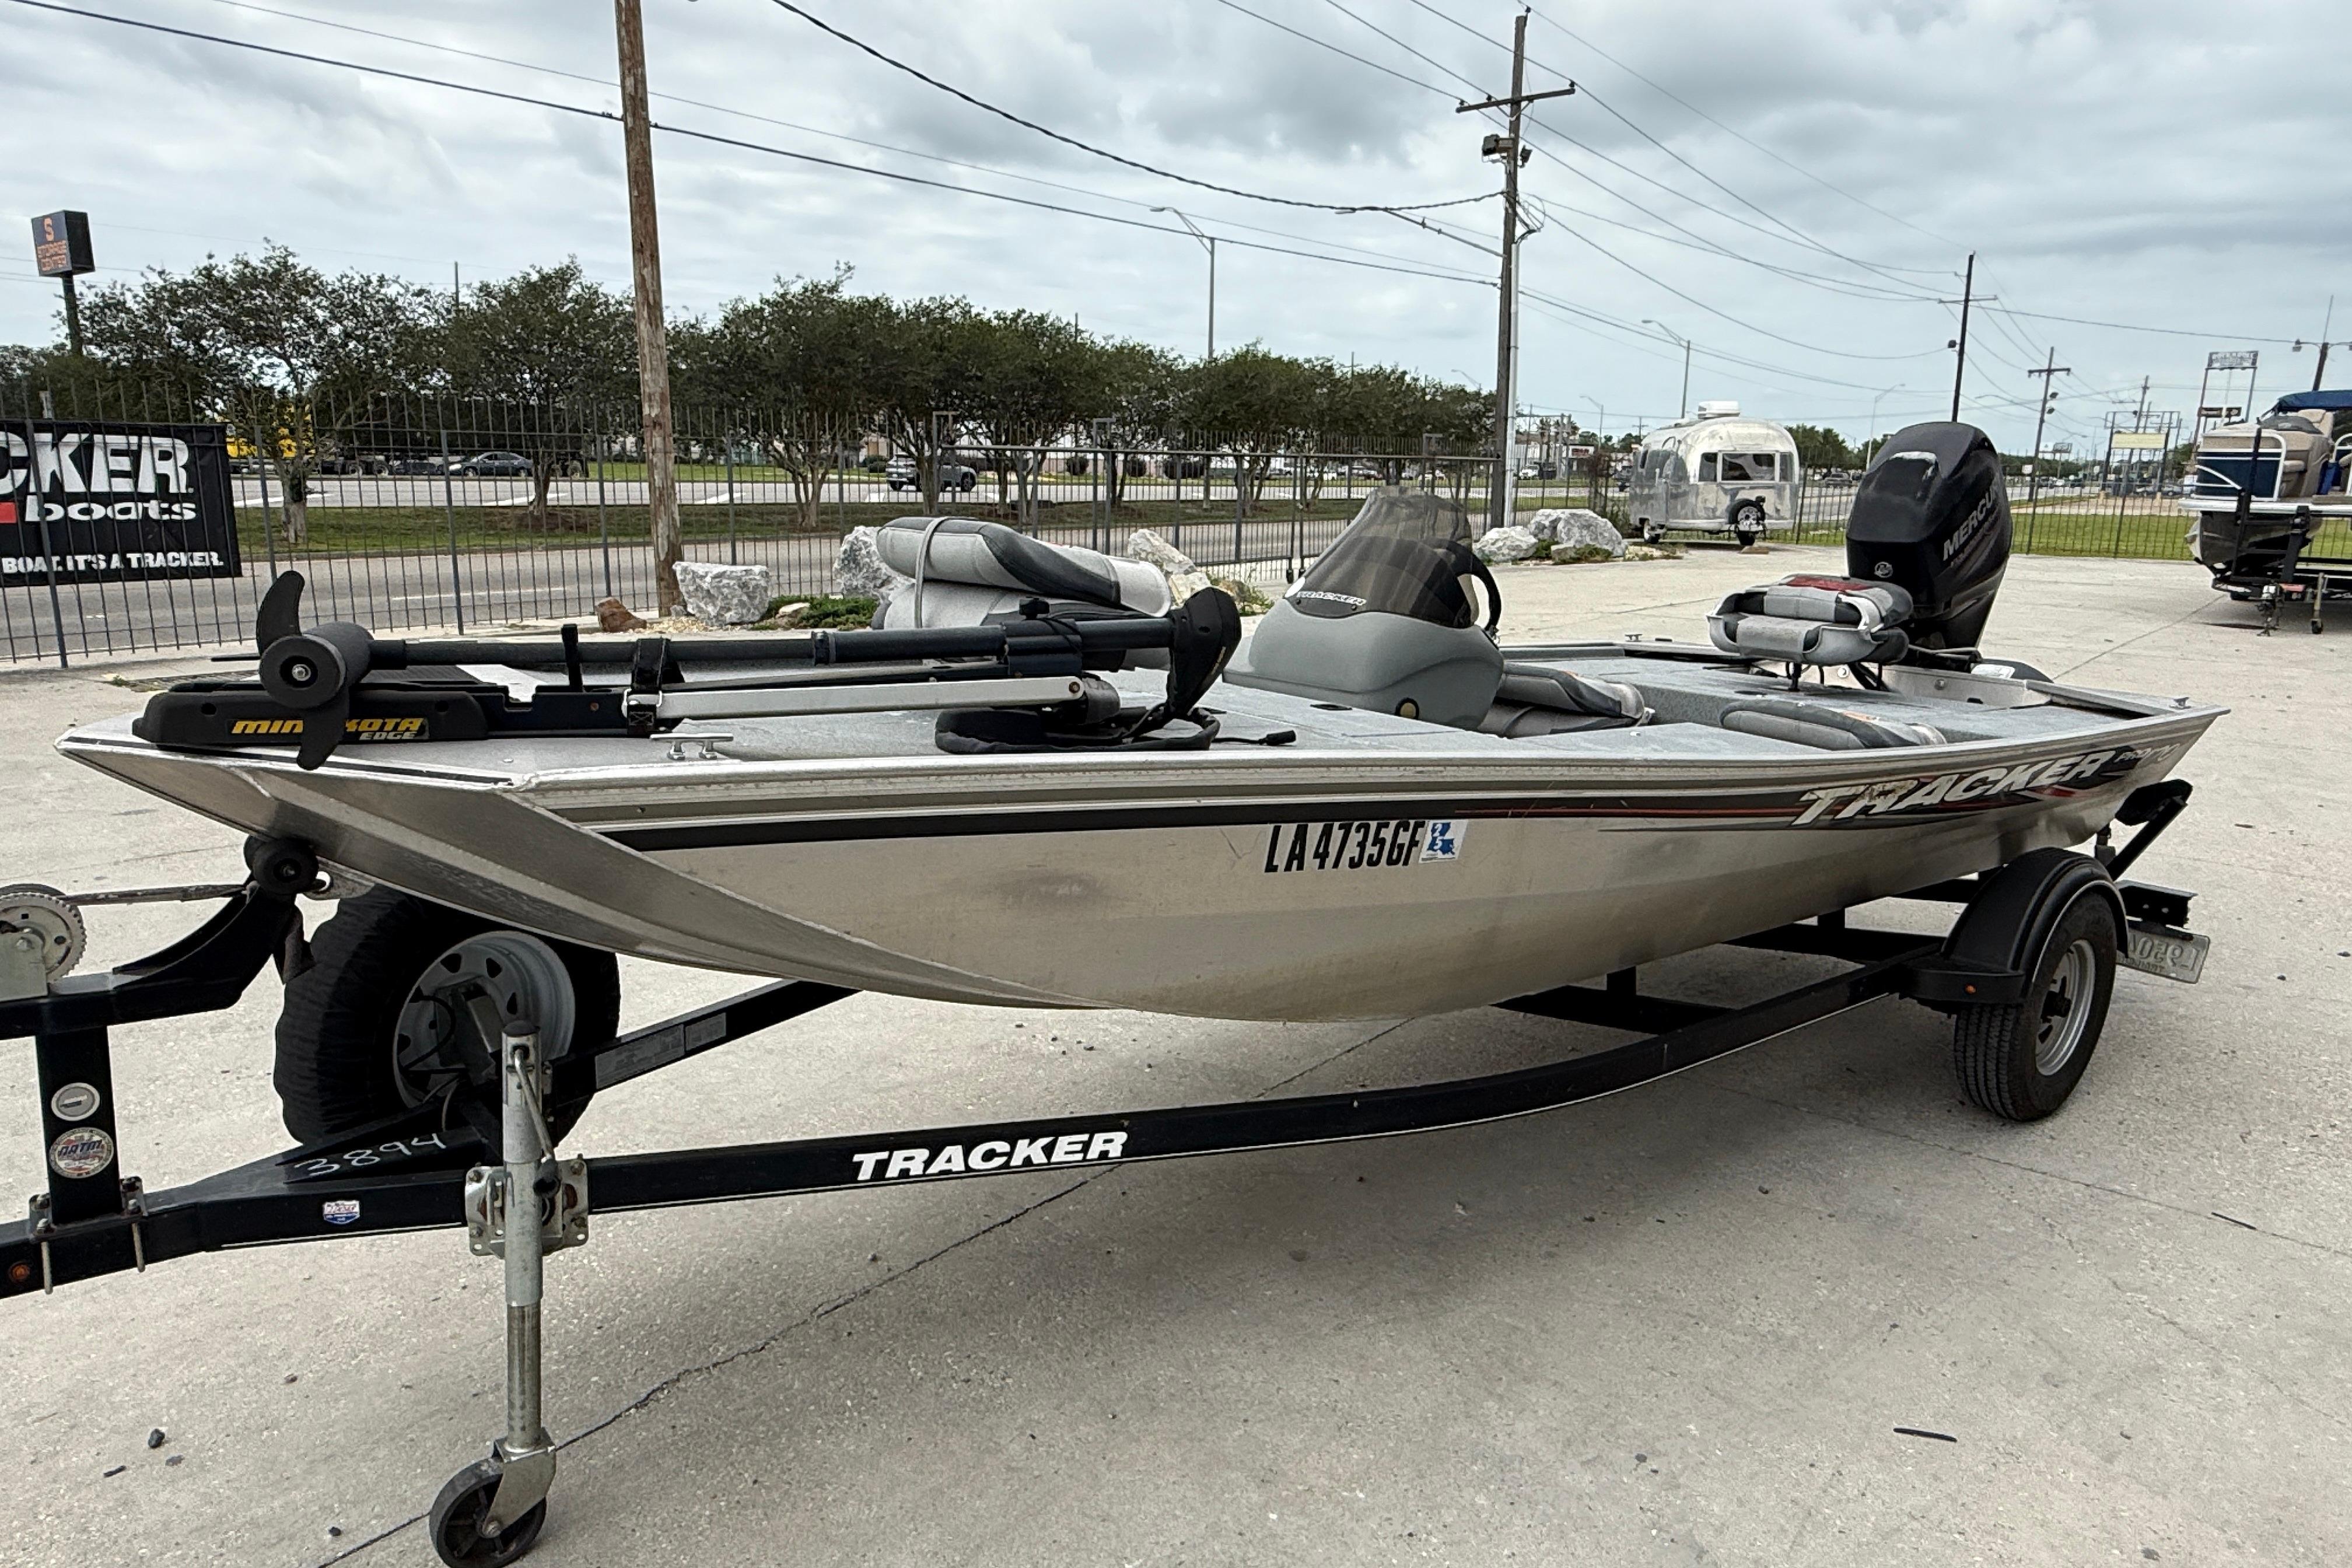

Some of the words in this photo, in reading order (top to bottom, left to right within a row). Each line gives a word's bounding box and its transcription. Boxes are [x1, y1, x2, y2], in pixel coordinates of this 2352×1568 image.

[25, 495, 197, 521] boats
[66, 554, 106, 571] IT'S
[110, 554, 123, 570] A
[232, 719, 303, 734] MIN
[359, 731, 416, 741] EDGE
[1791, 750, 2119, 827] TRACKER
[1264, 823, 1308, 873] LA
[294, 1133, 447, 1177] 3894
[852, 1131, 1128, 1181] TRACKER
